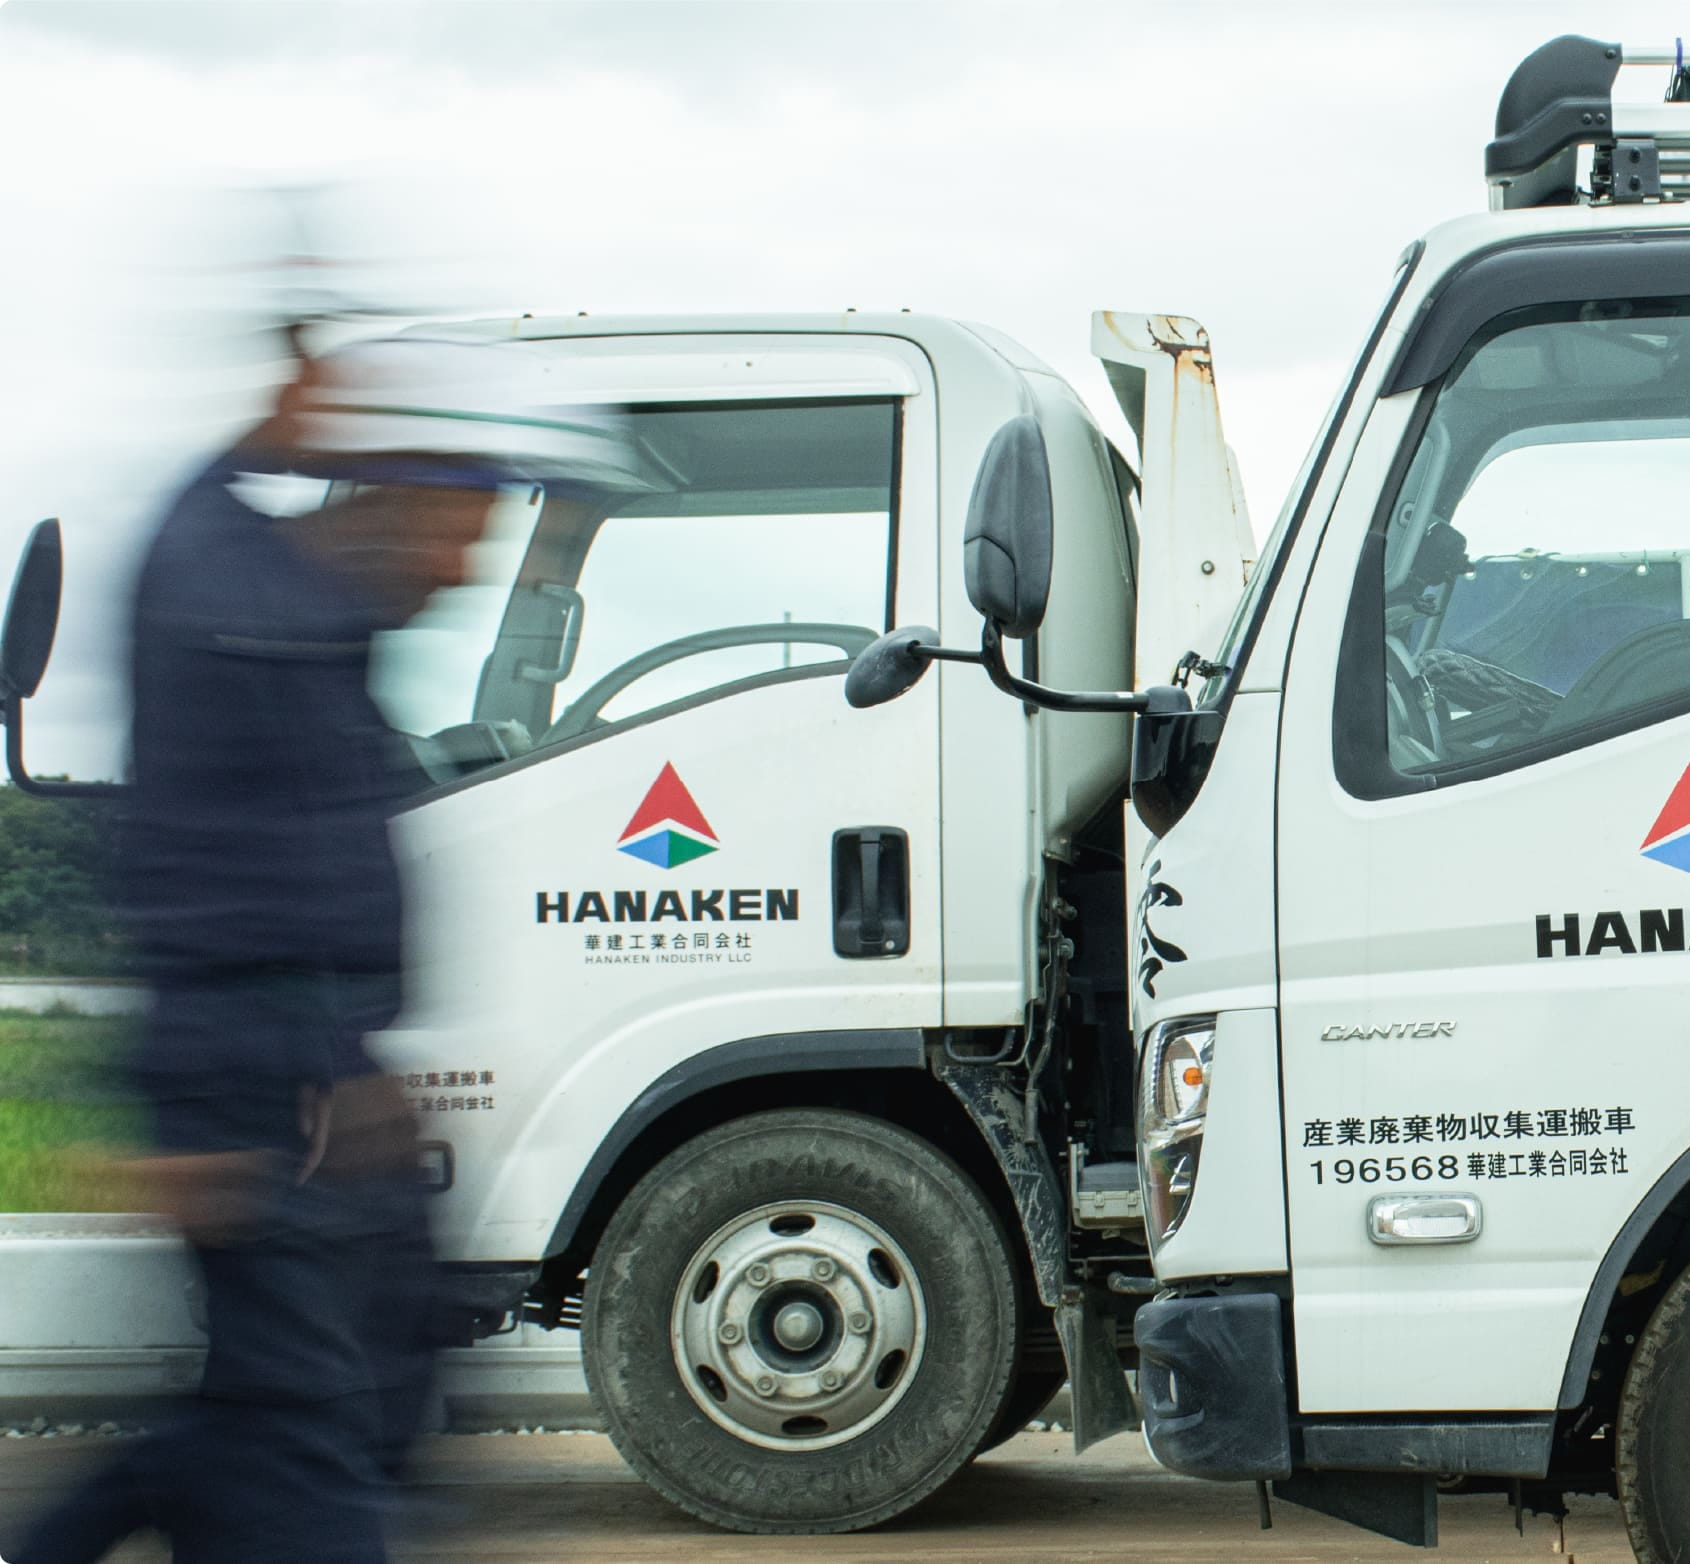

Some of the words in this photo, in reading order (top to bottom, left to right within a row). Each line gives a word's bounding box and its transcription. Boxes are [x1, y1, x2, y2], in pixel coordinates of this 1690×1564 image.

[536, 889, 799, 923] HANAKEN
[585, 932, 752, 951] 華建工業合同会社
[585, 954, 650, 965] HANAKEN
[656, 953, 722, 964] INDUSTRY
[728, 953, 752, 963] LLC
[1321, 1020, 1457, 1042] CANTER
[1302, 1106, 1636, 1147] 産業廃棄物収集運搬車
[1310, 1154, 1459, 1185] 196568
[1467, 1147, 1629, 1180] 華建工業合同会社
